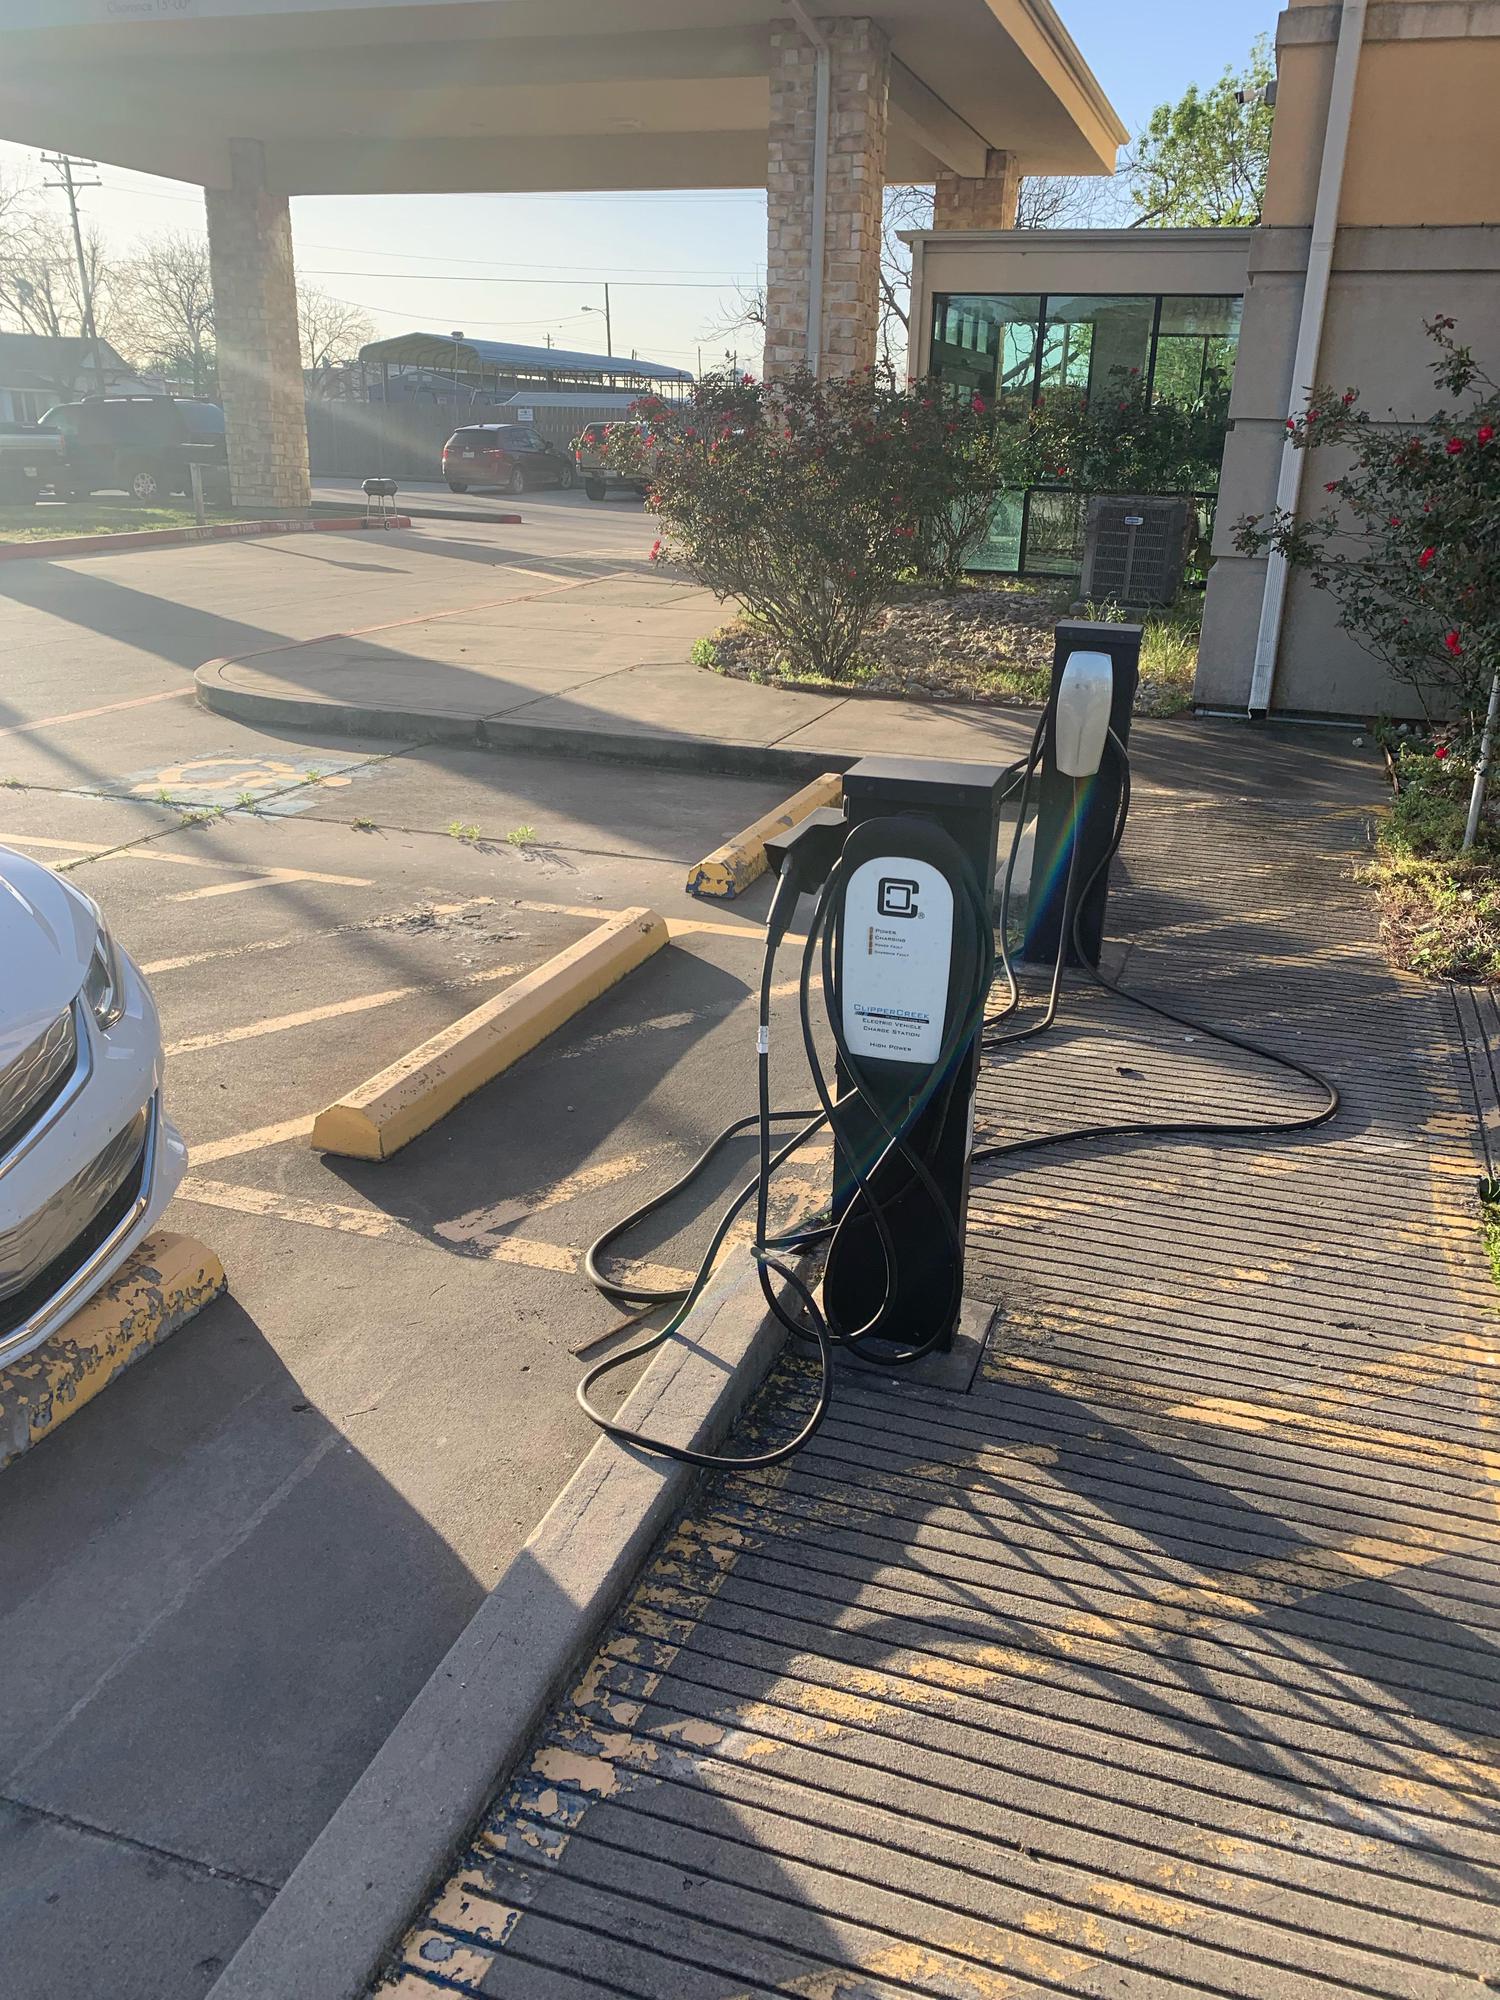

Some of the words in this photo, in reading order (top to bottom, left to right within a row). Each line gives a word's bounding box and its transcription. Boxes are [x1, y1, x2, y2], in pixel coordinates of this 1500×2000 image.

[862, 1018, 893, 1026] ELECTRIC
[894, 1022, 922, 1030] VEHICLE
[863, 1025, 890, 1034] CHARGE
[892, 1029, 921, 1038] STATION
